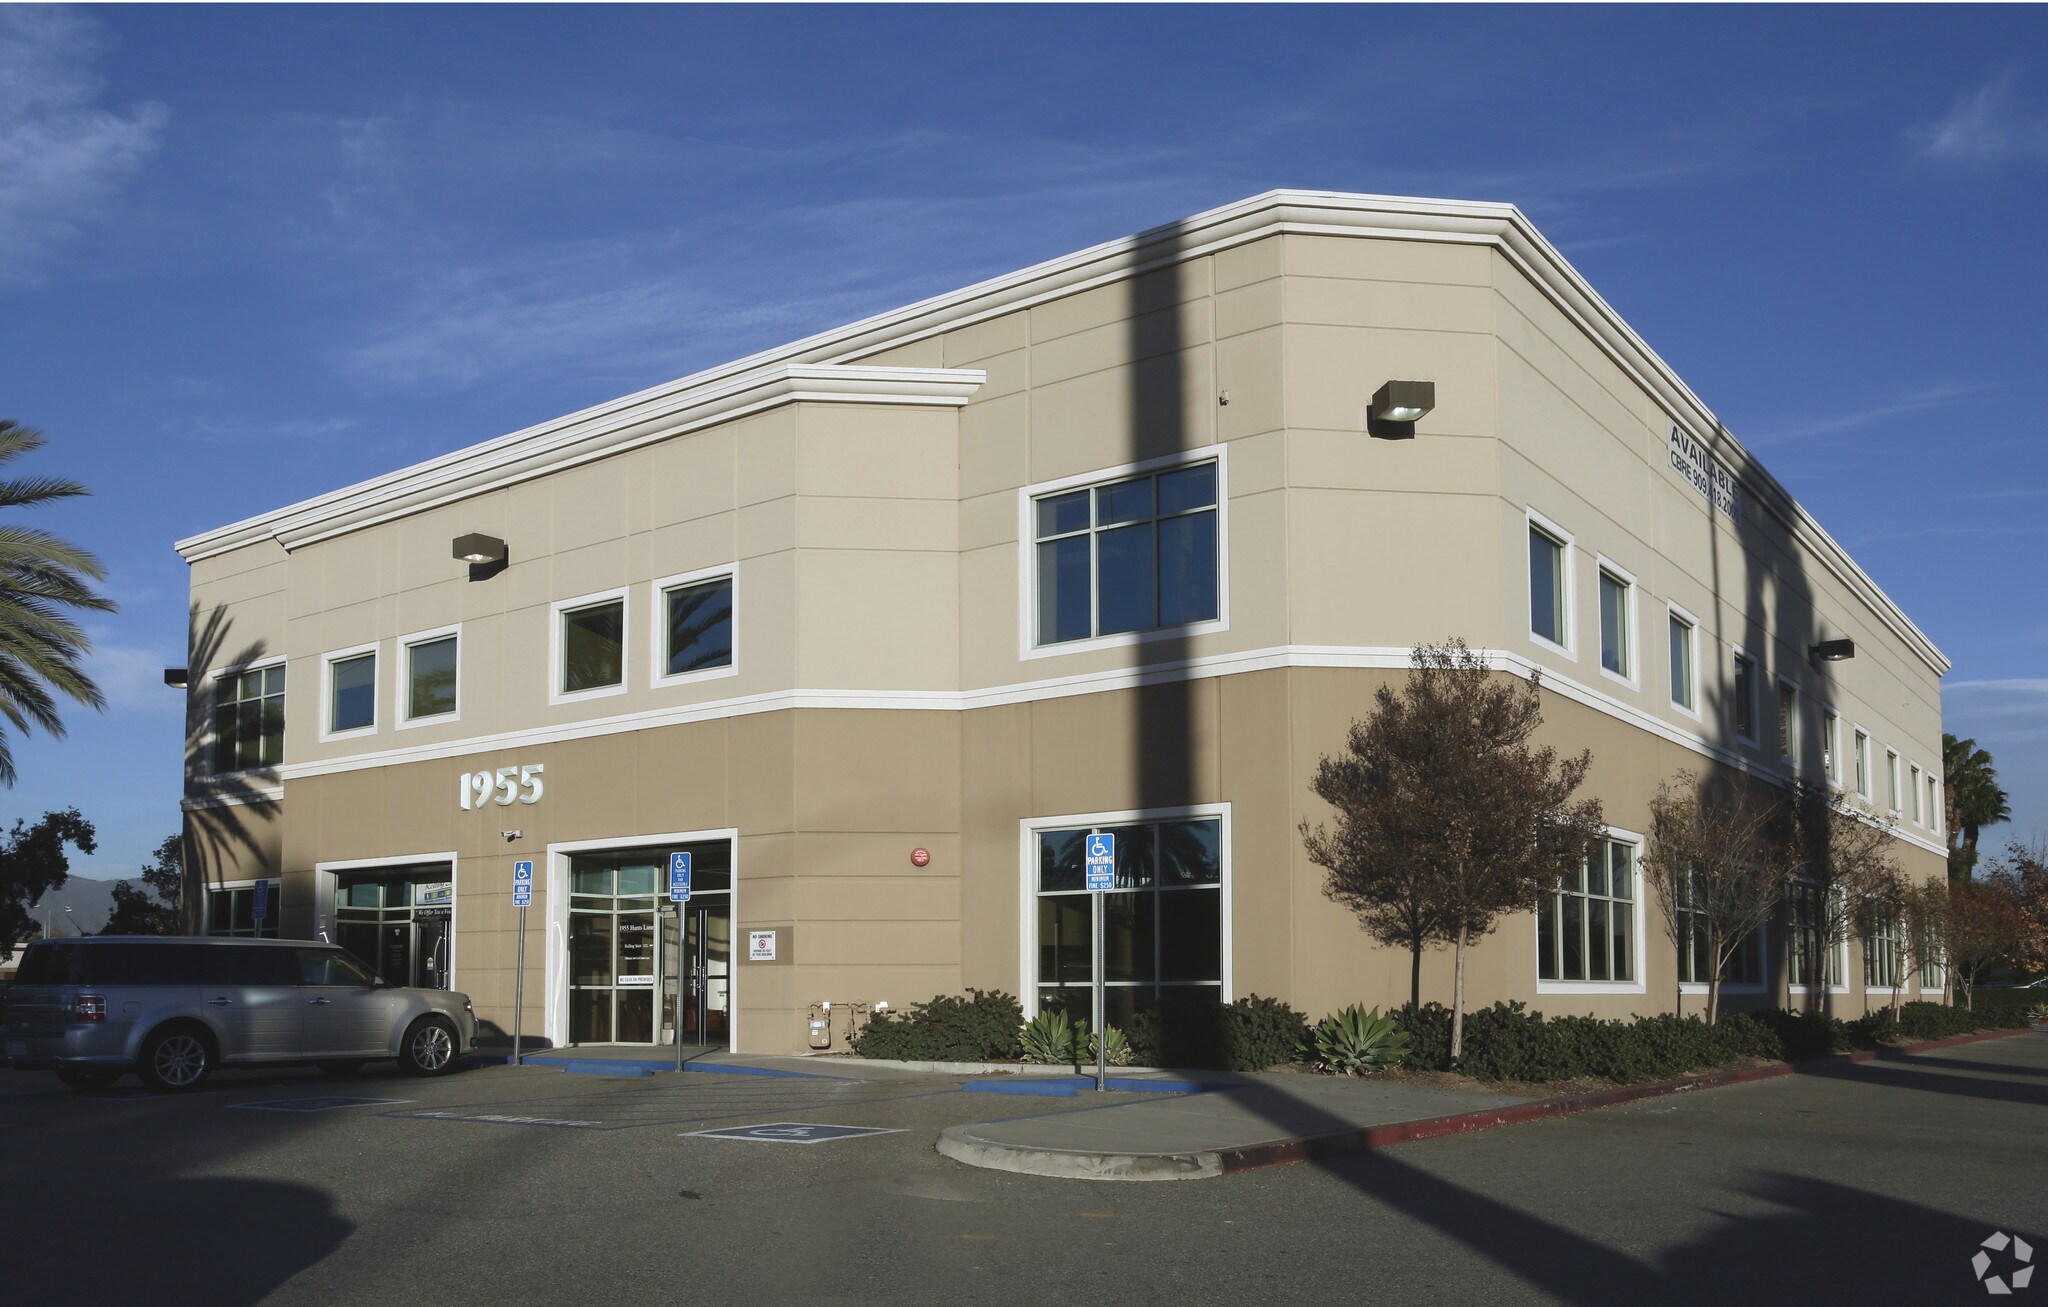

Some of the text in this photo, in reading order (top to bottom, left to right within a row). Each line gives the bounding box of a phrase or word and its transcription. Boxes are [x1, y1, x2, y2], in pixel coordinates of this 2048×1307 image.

[1671, 426, 1739, 500] AVAILABLE
[1671, 450, 1692, 481] CBRE
[460, 763, 544, 811] 1955
[1087, 856, 1112, 865] PARKING
[1093, 865, 1107, 873] ONLY
